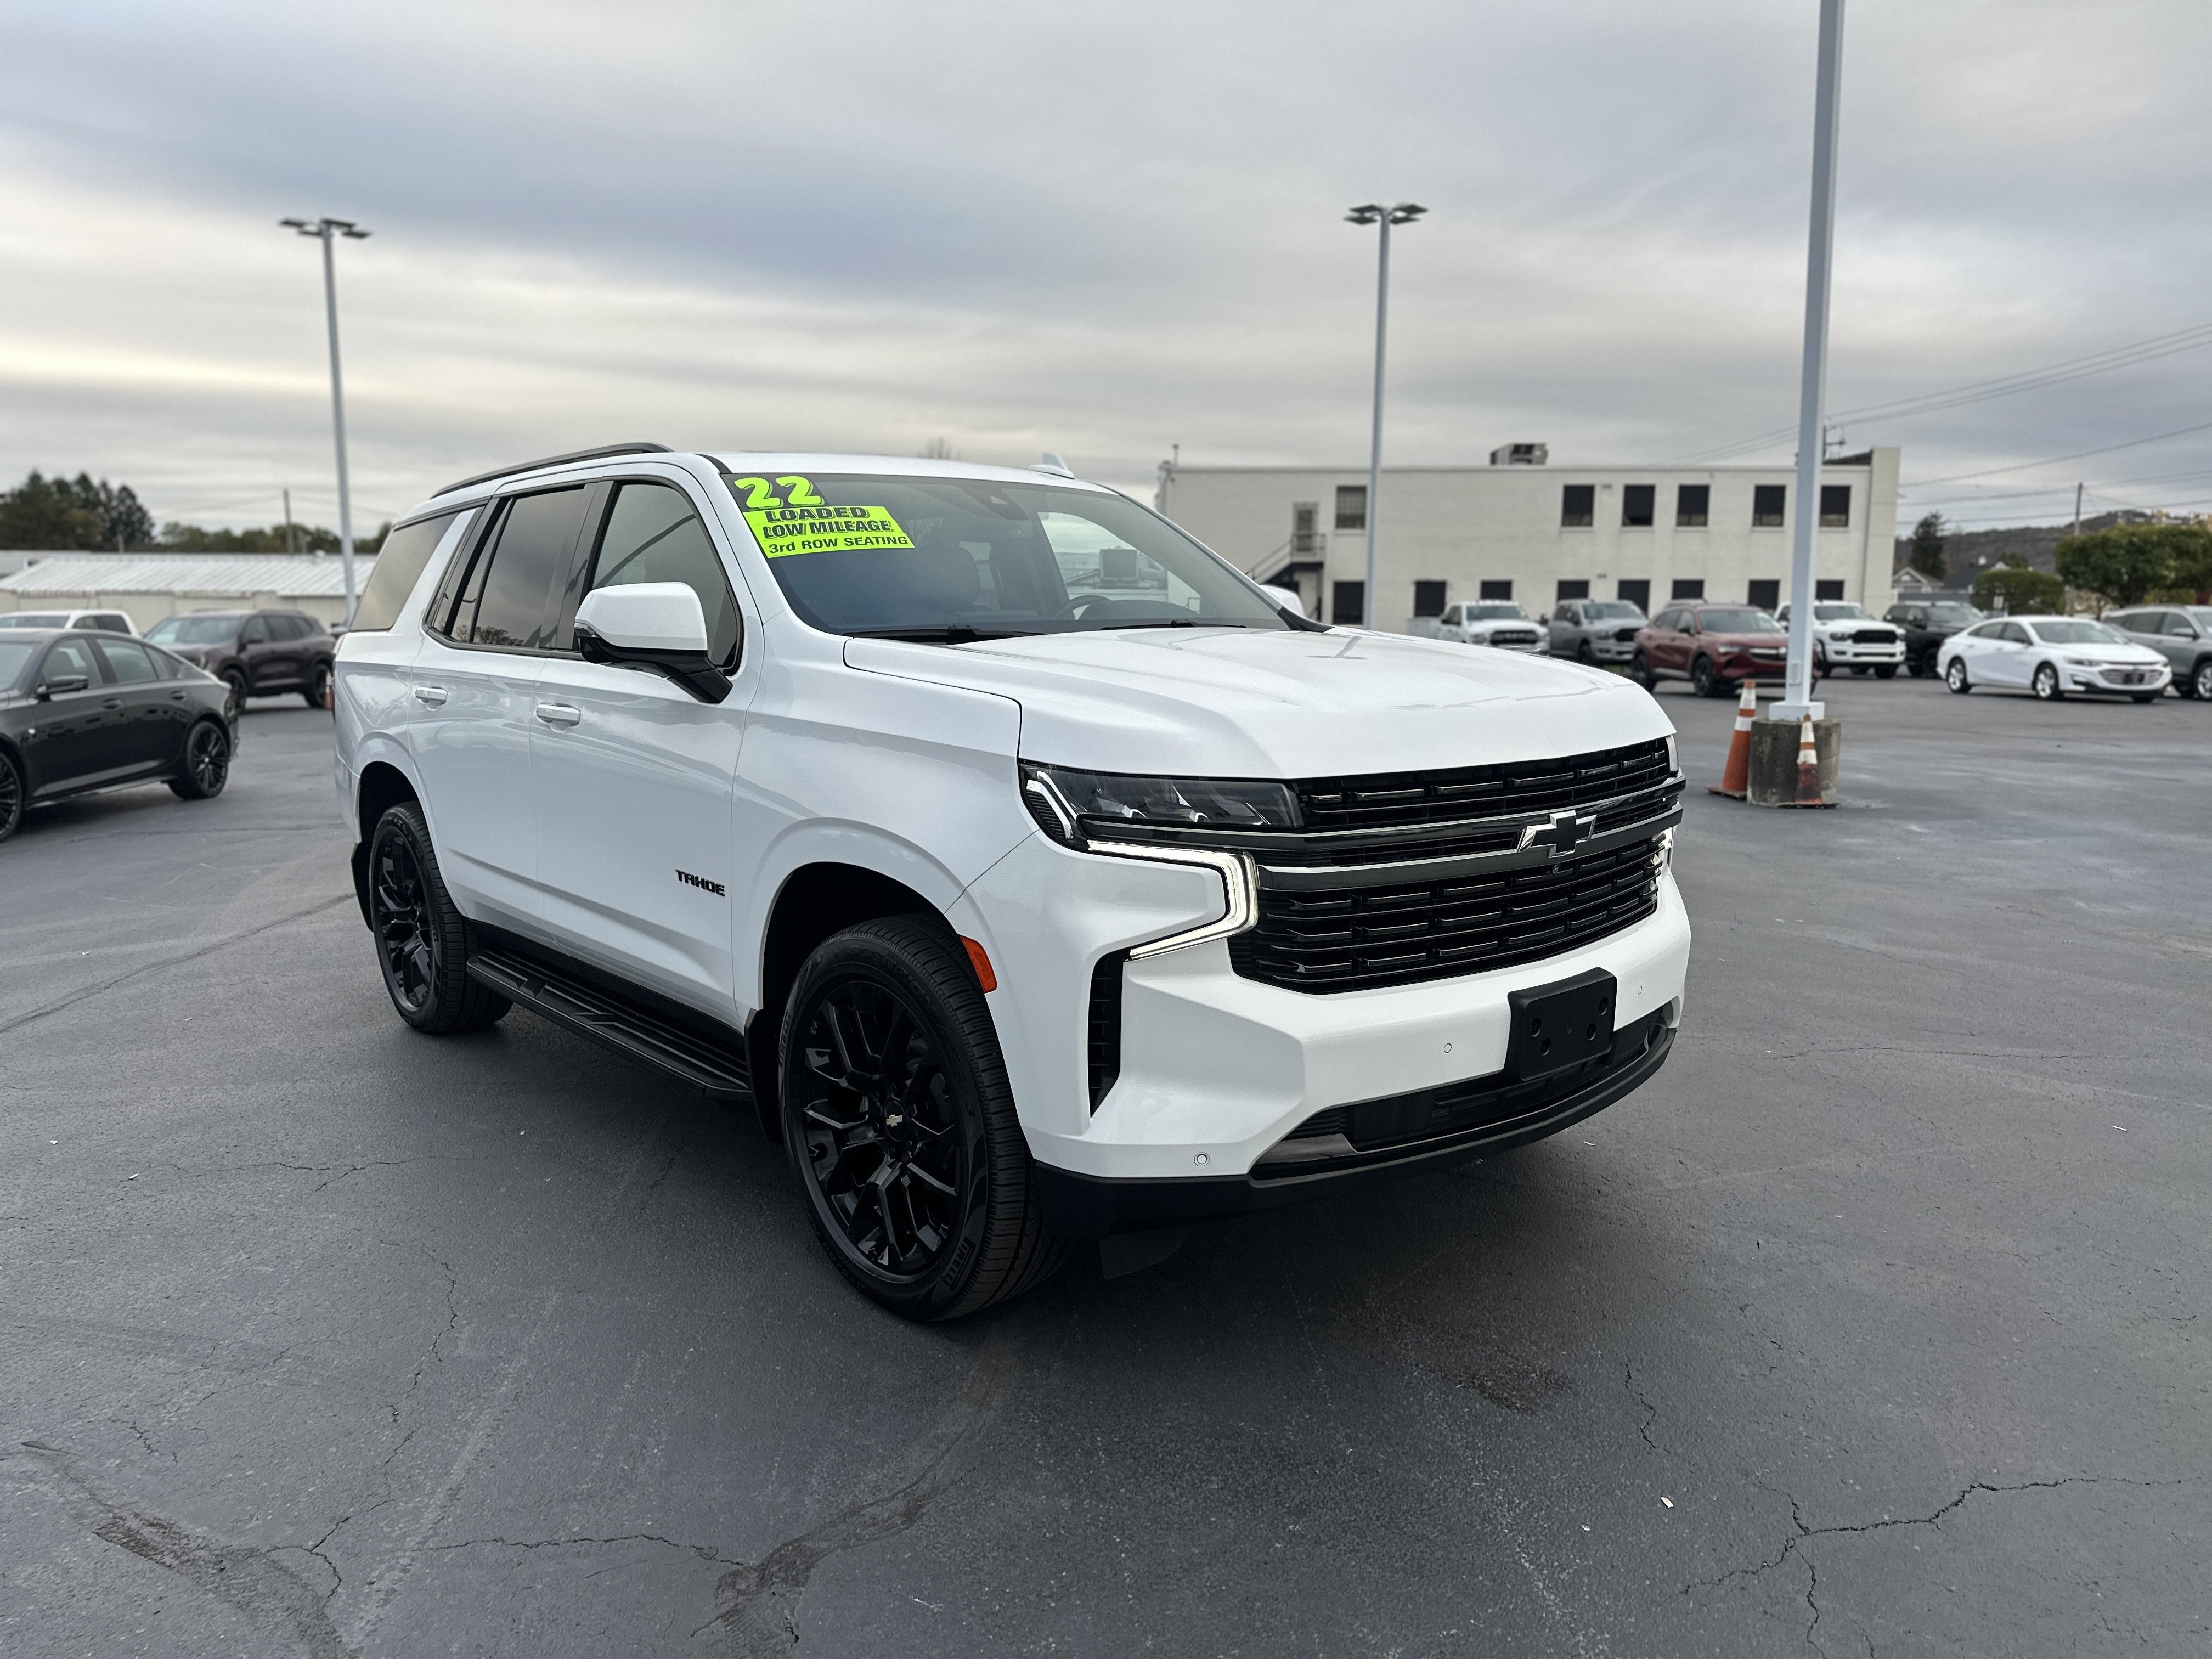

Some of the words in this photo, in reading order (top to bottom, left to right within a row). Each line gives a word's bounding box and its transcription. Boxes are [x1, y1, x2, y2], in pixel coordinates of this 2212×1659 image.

[734, 476, 825, 508] 22
[765, 507, 870, 523] LOADED
[763, 523, 806, 539] LOW
[810, 520, 892, 534] MILEAGE
[769, 541, 795, 554] 3rd
[801, 538, 838, 550] ROW
[844, 535, 908, 547] SEATING
[675, 868, 725, 897] TAHOE
[941, 1235, 977, 1291] PIRELLI
